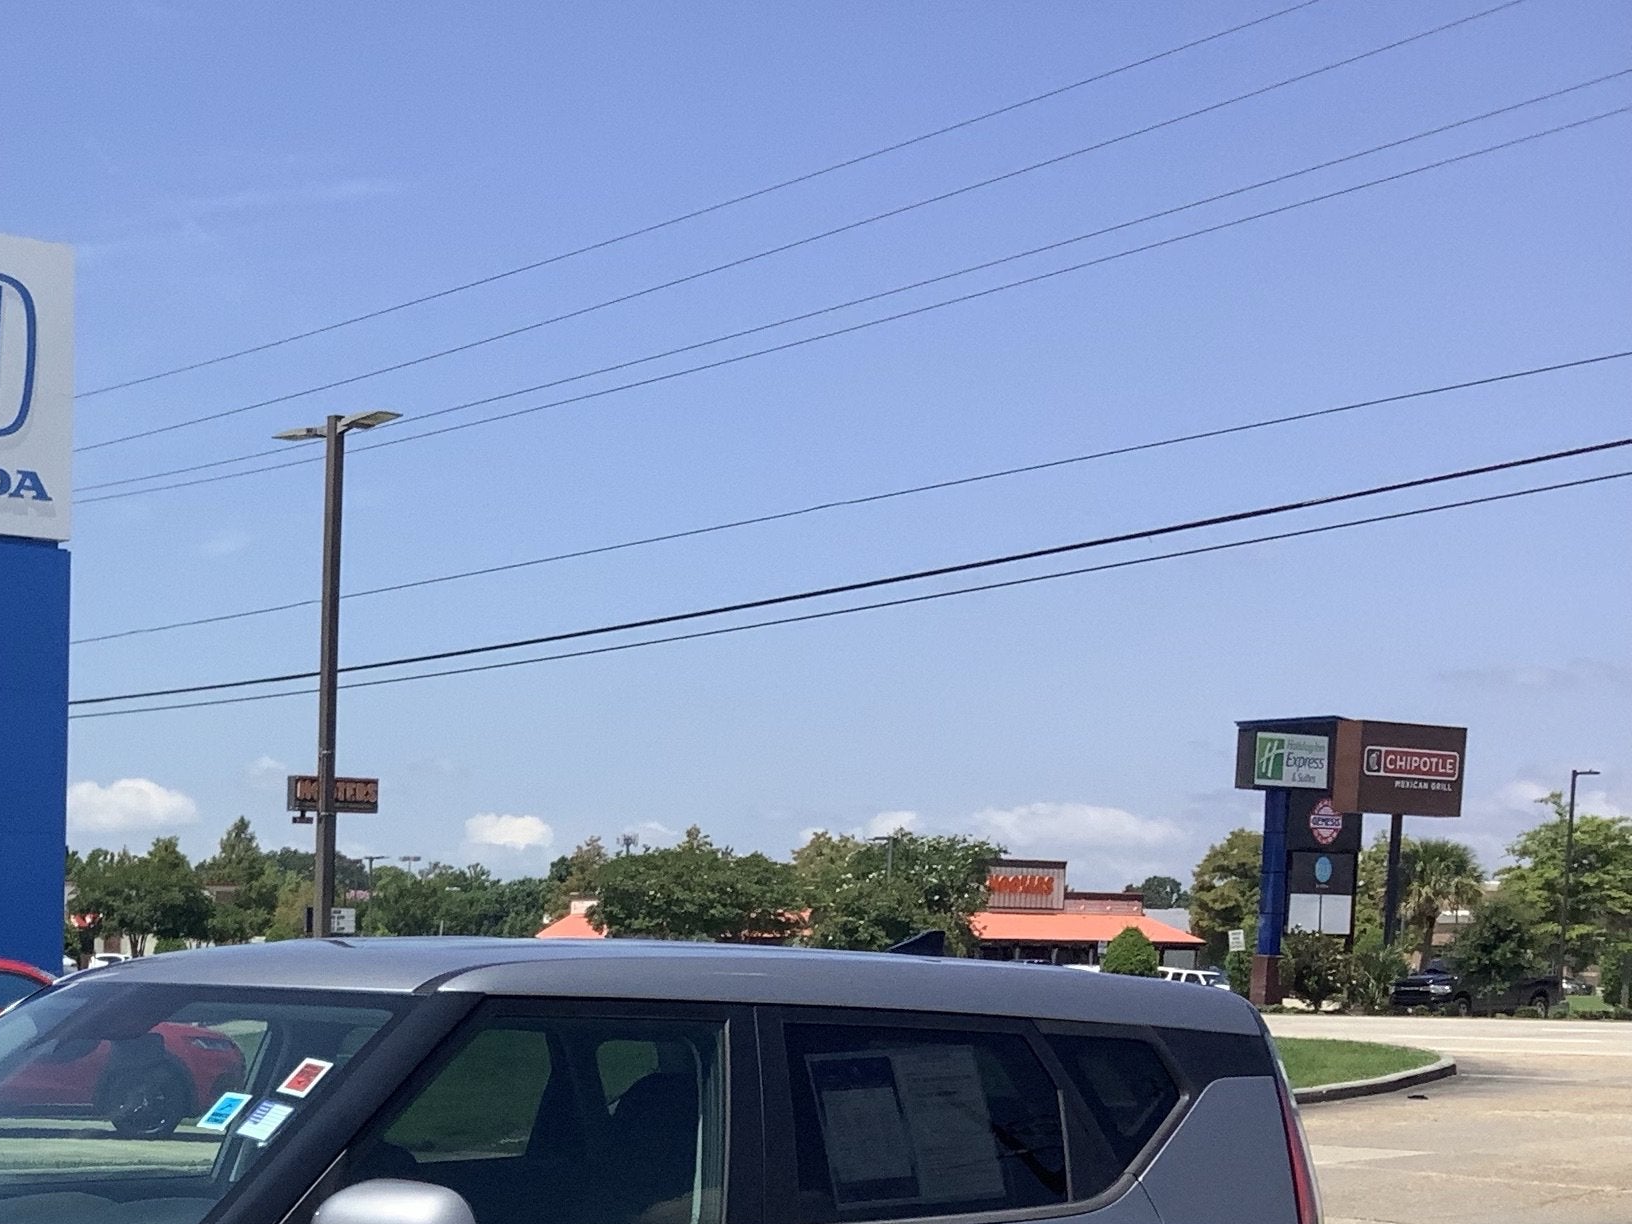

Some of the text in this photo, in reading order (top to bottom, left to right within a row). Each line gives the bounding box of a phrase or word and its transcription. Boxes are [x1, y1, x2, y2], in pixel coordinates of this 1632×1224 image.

[1286, 751, 1325, 772] Express
[1386, 754, 1455, 774] CHIPOTLE
[1394, 780, 1453, 792] MEXICAN GRILL
